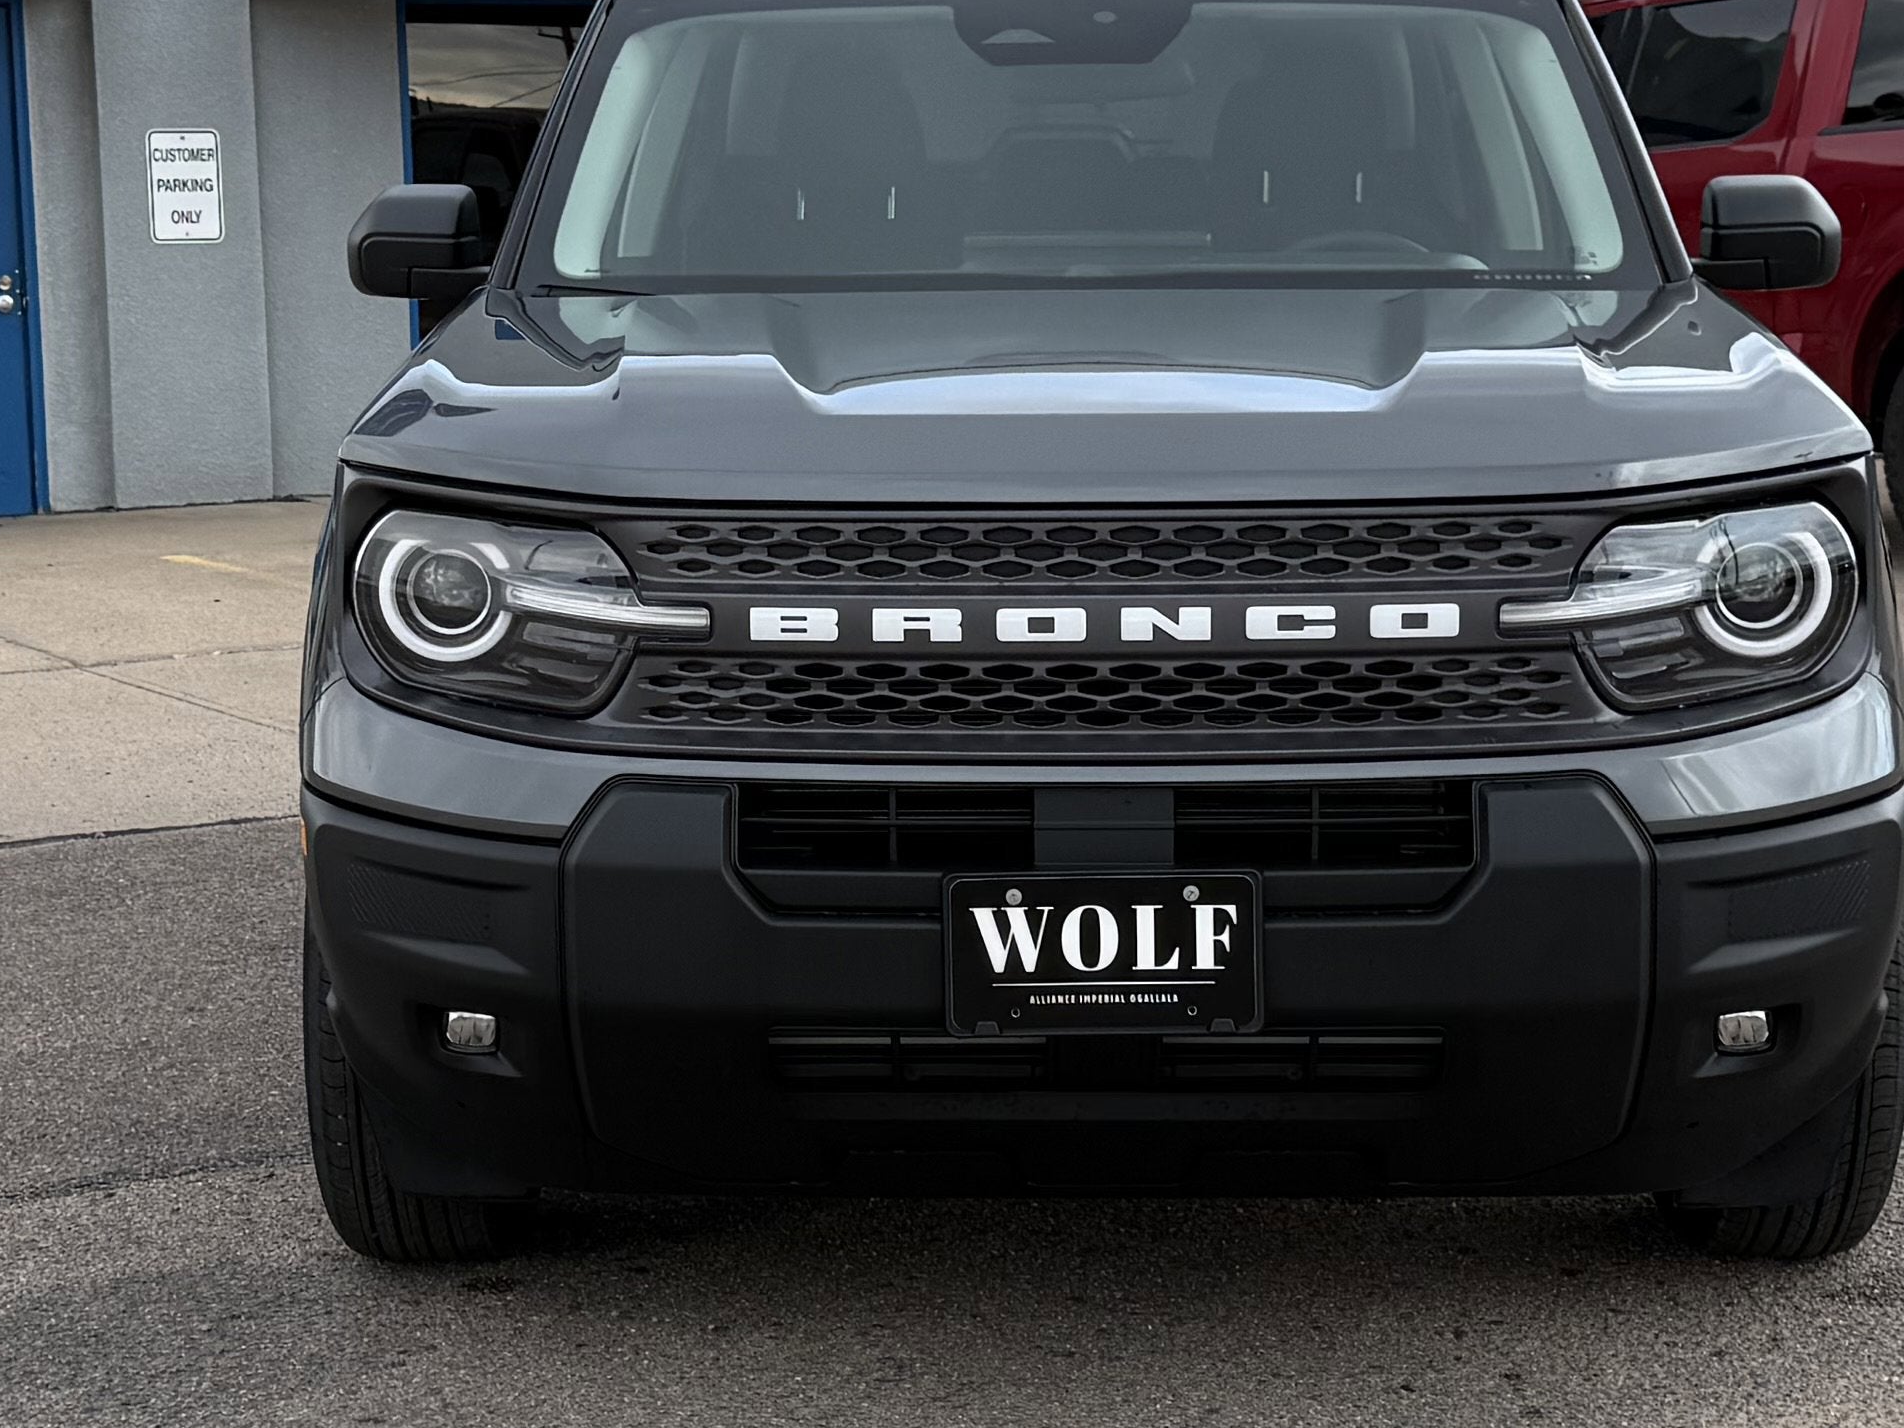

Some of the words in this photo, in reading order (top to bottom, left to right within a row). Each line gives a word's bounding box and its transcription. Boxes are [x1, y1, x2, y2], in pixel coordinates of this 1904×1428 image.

[153, 148, 214, 162] CUSTOMER
[157, 178, 214, 192] PARKING
[171, 210, 202, 224] ONLY
[749, 603, 1460, 643] BRONCO
[969, 904, 1238, 974] WOLF
[1029, 994, 1076, 1004] ALLIANCE
[1079, 994, 1126, 1004] IMPERIAL
[1129, 993, 1179, 1003] OGALLALA
